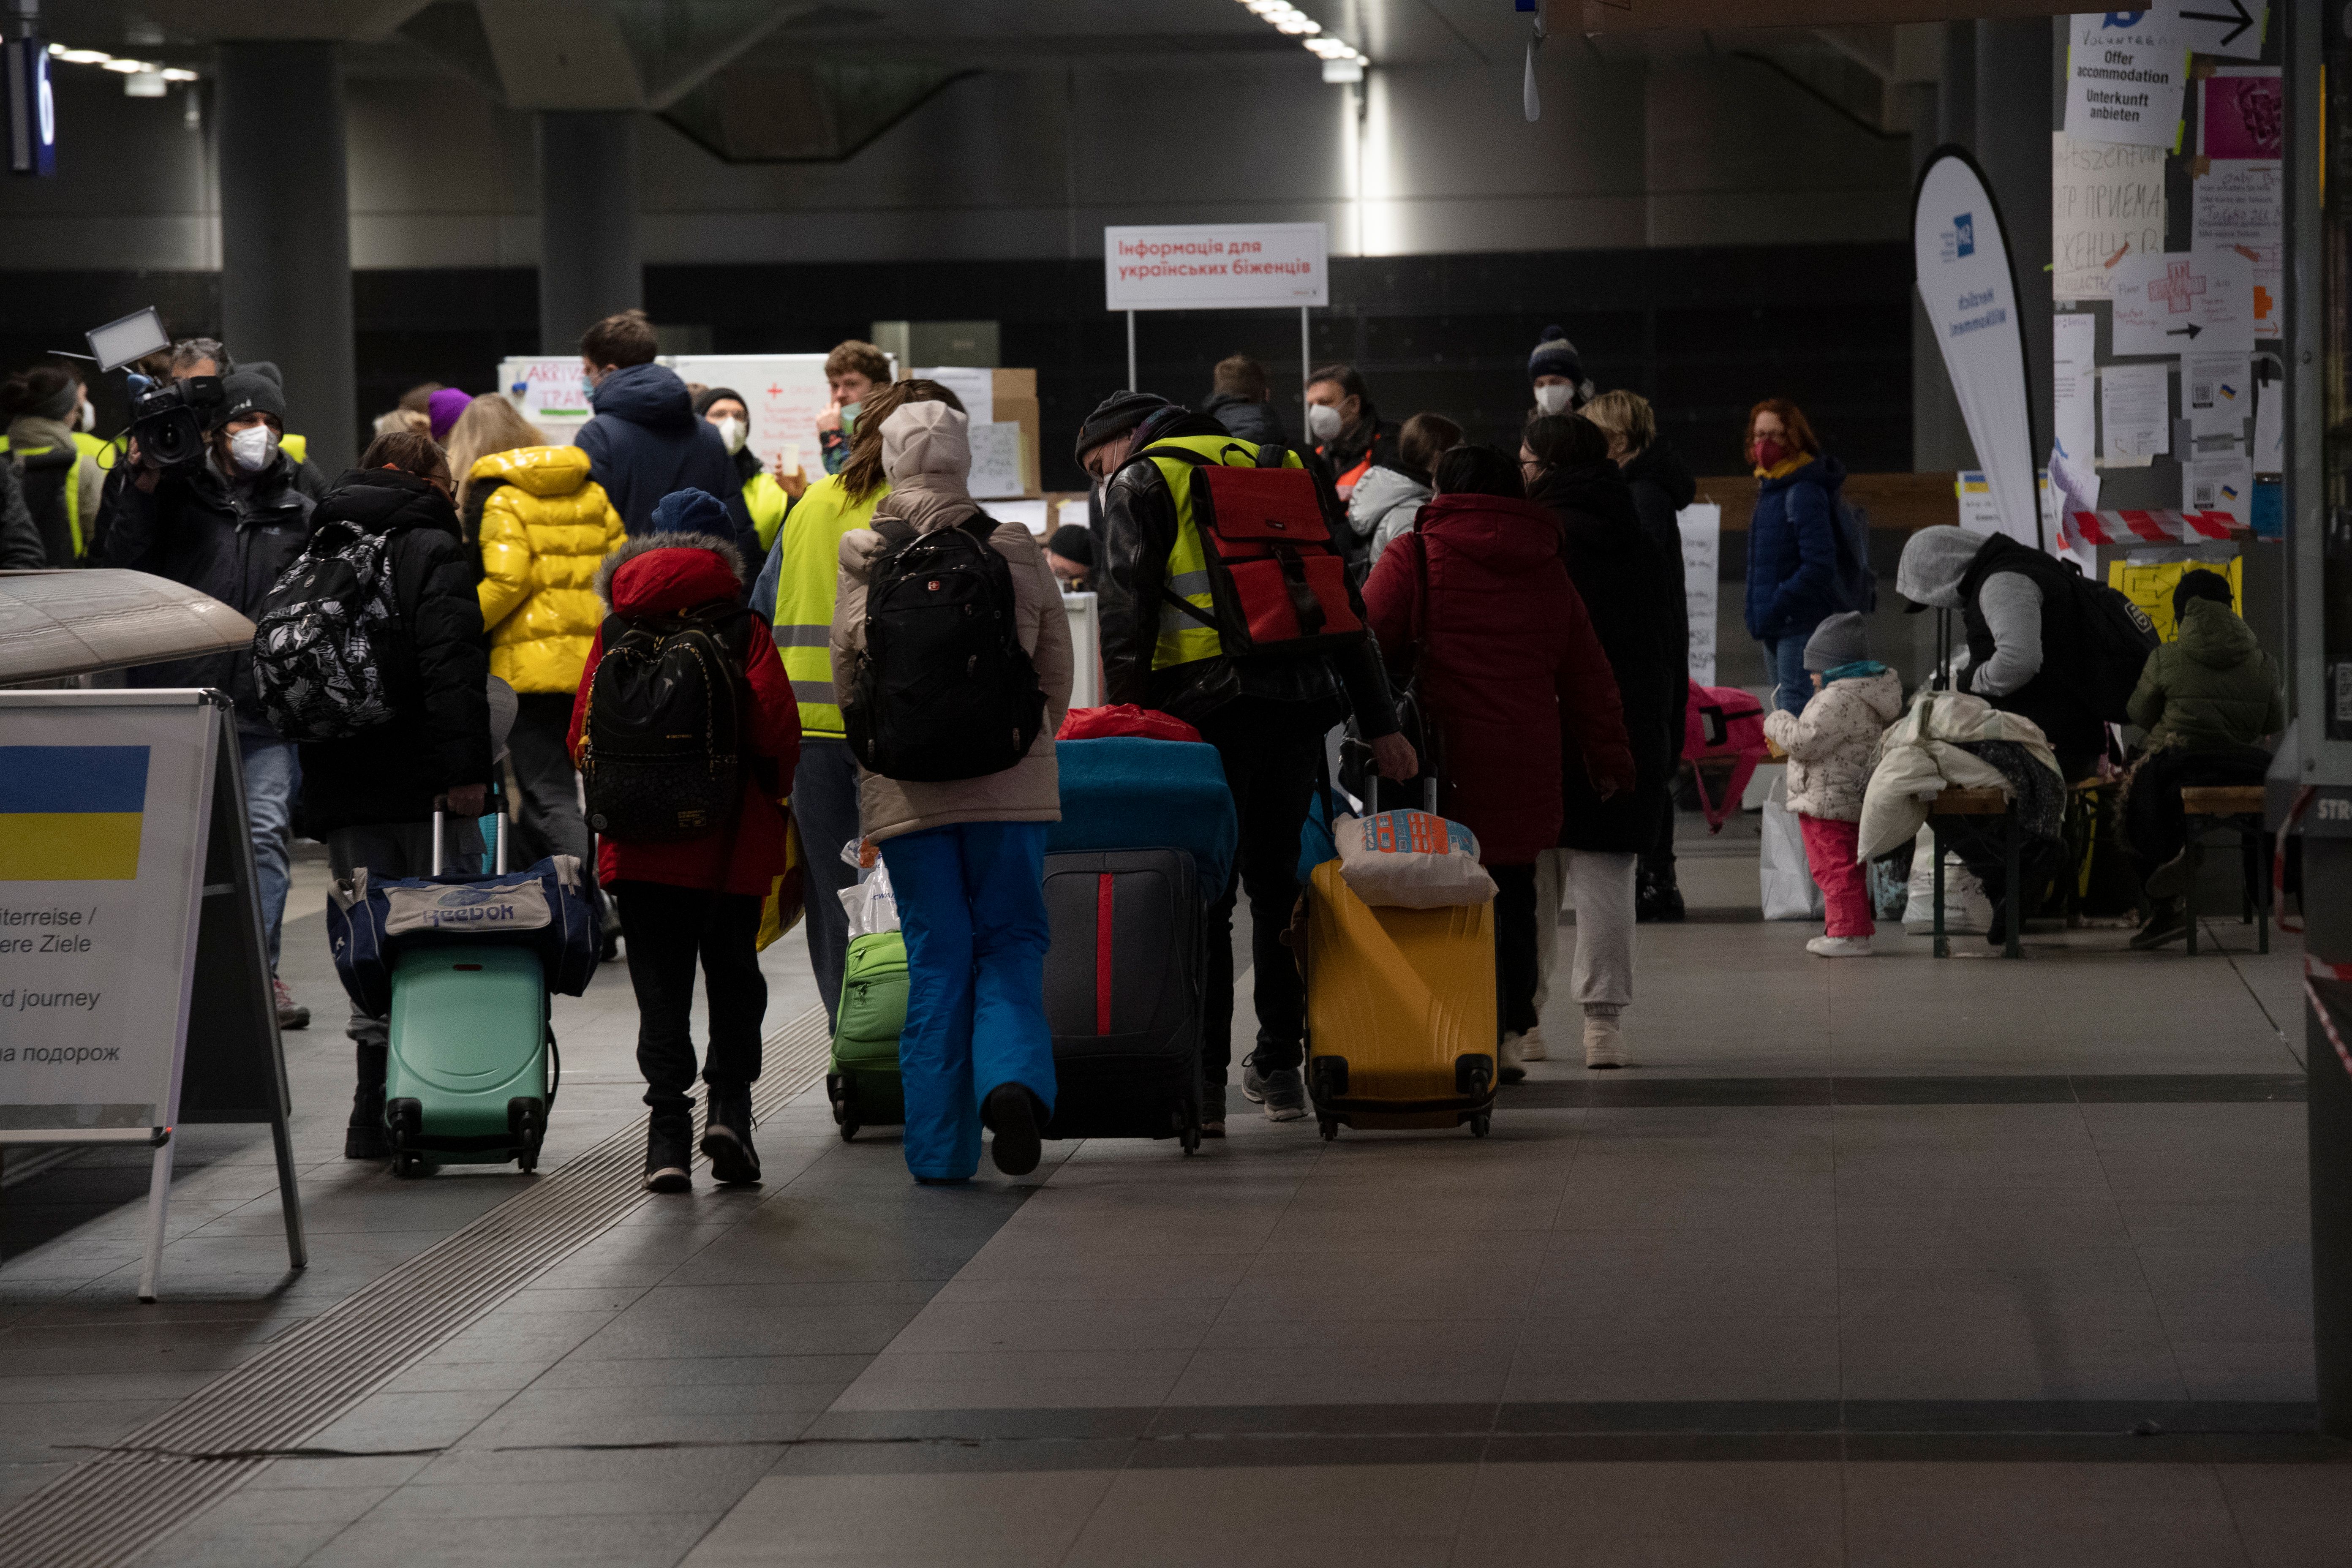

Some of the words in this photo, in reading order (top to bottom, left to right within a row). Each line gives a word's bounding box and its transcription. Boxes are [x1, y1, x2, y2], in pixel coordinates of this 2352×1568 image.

[2104, 50, 2134, 65] Offer
[2077, 65, 2169, 84] accommodation
[2086, 89, 2149, 107] Unterkunft
[2090, 106, 2140, 122] anbieten
[1118, 239, 1223, 259] Інформація
[1227, 240, 1262, 256] для
[1118, 262, 1228, 281] українських
[1233, 258, 1311, 276] біженців
[2318, 798, 2352, 820] STR
[88, 907, 97, 925] /
[422, 904, 514, 927] Reebok
[39, 934, 91, 953] Ziele
[19, 989, 101, 1011] journey
[23, 1047, 120, 1065] подорож
